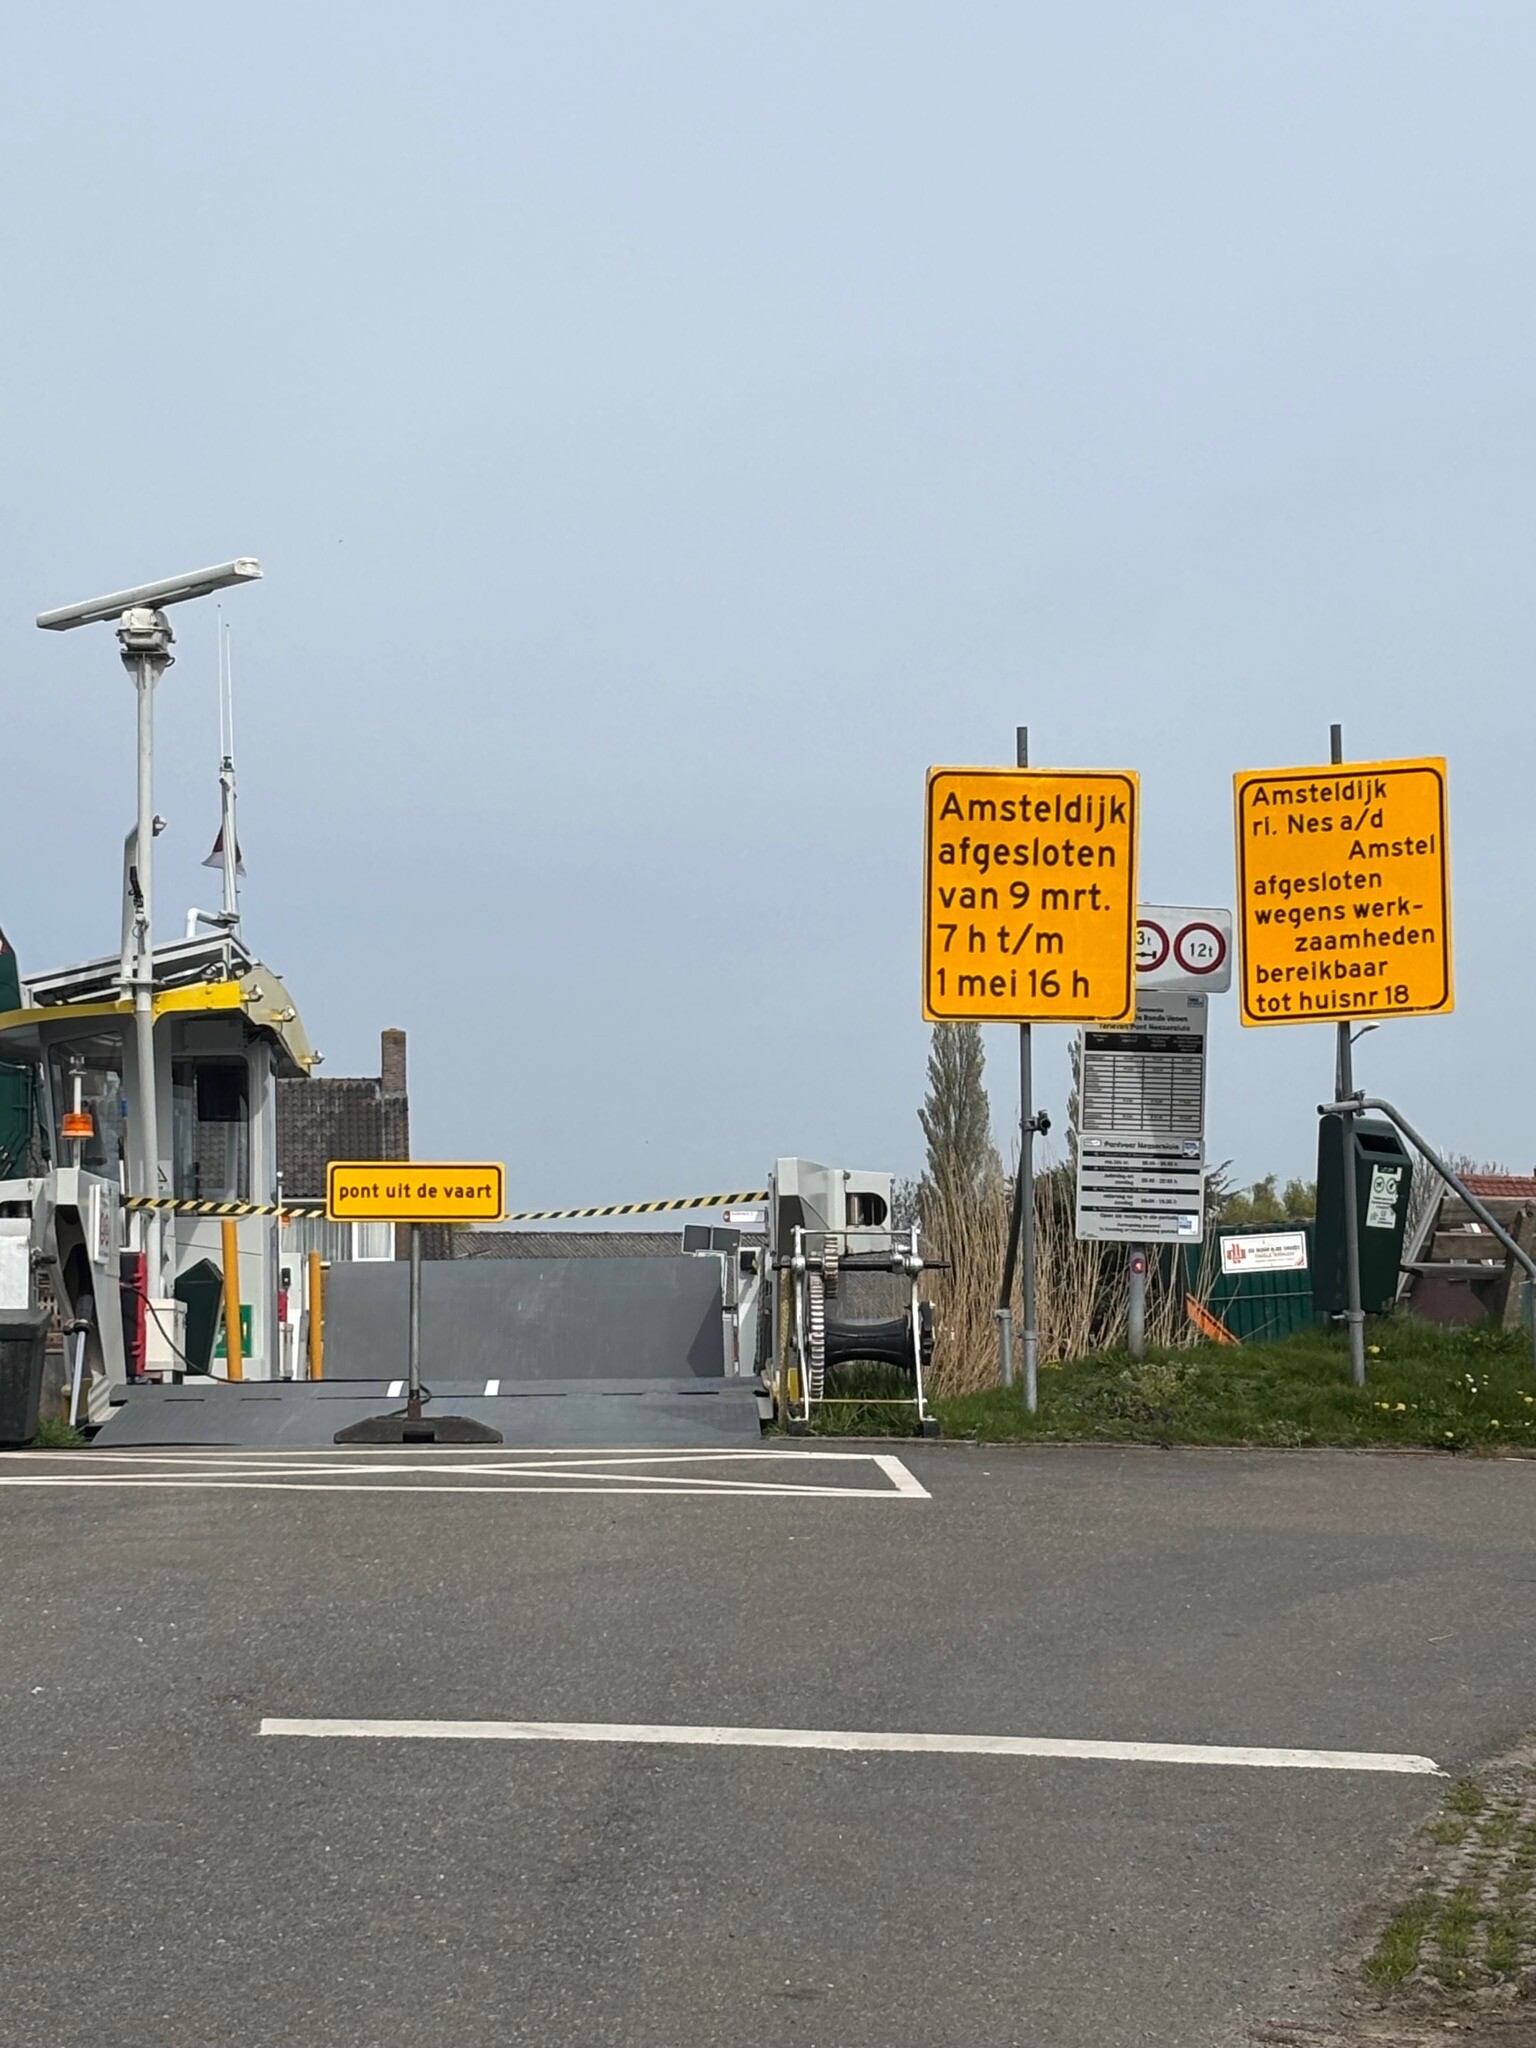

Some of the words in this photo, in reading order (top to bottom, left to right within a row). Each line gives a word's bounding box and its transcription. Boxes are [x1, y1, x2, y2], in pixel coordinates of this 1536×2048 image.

[1251, 778, 1387, 807] Amsteldijk
[939, 791, 1126, 833] Amsteldijk
[1287, 815, 1333, 835] Nes
[1339, 807, 1383, 832] a/d
[938, 836, 1116, 875] afgesloten
[1348, 834, 1435, 861] Amstel
[938, 886, 998, 909] van
[1009, 881, 1030, 910] 9
[1041, 883, 1111, 911] mrt.
[1253, 871, 1382, 900] afgesloten
[1254, 903, 1346, 930] wegens
[1353, 895, 1423, 919] werk-
[937, 923, 958, 953] 7
[968, 923, 986, 953] h
[997, 923, 1064, 956] t/m
[1190, 942, 1214, 958] 12t
[1294, 925, 1435, 953] zaamheden
[937, 967, 945, 997] 1
[958, 969, 1017, 997] mei
[1028, 968, 1061, 998] 16
[1072, 969, 1089, 998] h
[1256, 959, 1389, 984] bereikbaar
[1255, 992, 1291, 1013] tot
[1299, 990, 1379, 1010] huisnr
[1385, 984, 1410, 1005] 18
[339, 1182, 379, 1201] pont
[386, 1182, 411, 1199] uit
[417, 1182, 438, 1199] de
[443, 1183, 492, 1199] vaart
